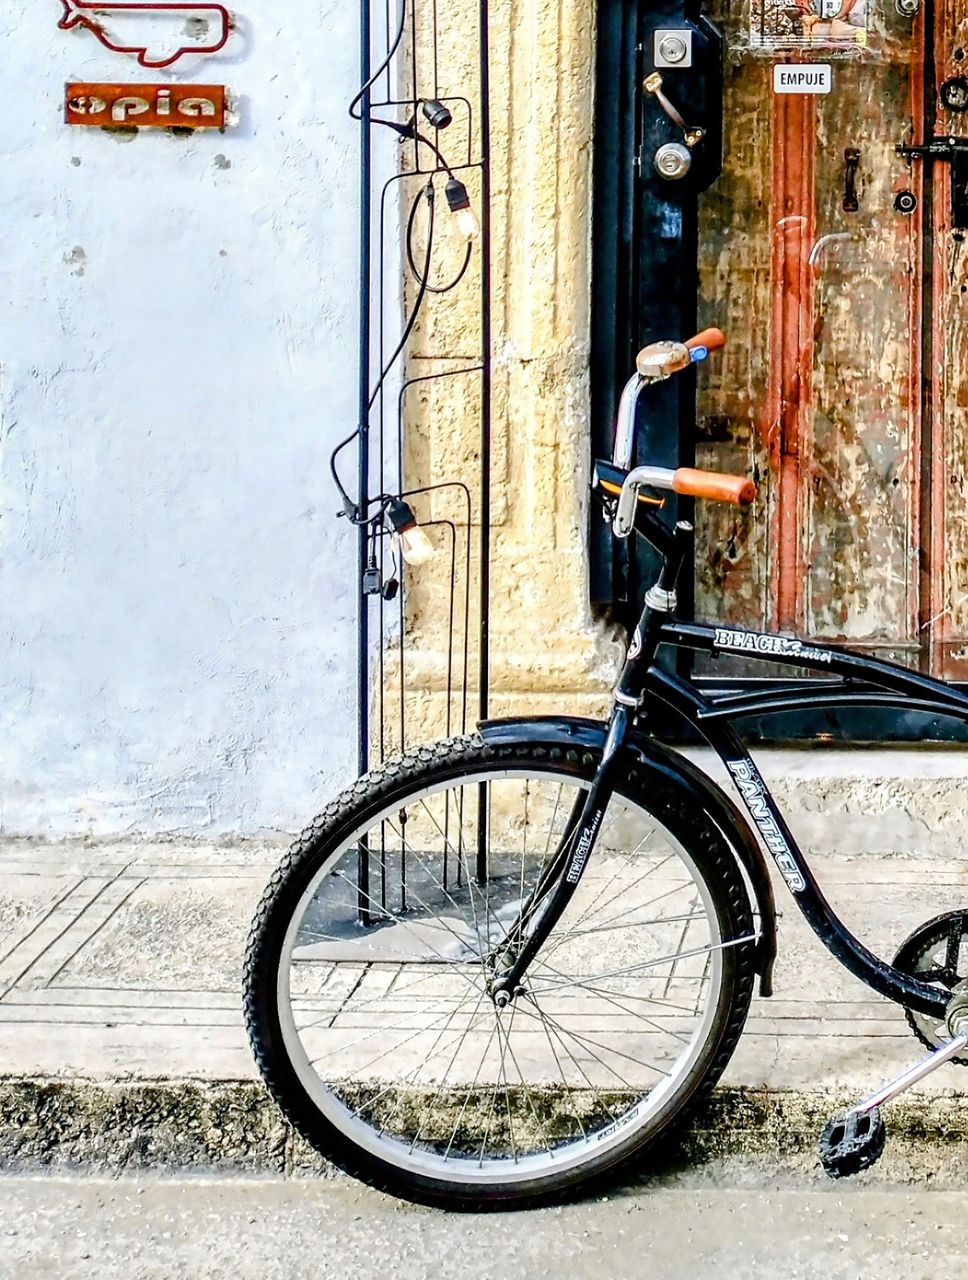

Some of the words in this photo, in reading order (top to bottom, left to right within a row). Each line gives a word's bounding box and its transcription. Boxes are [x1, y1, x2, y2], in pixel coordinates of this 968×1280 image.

[780, 73, 825, 86] EMPUJE
[713, 629, 784, 655] BEACH
[726, 758, 807, 894] PANTHER
[566, 836, 592, 884] BEACH
